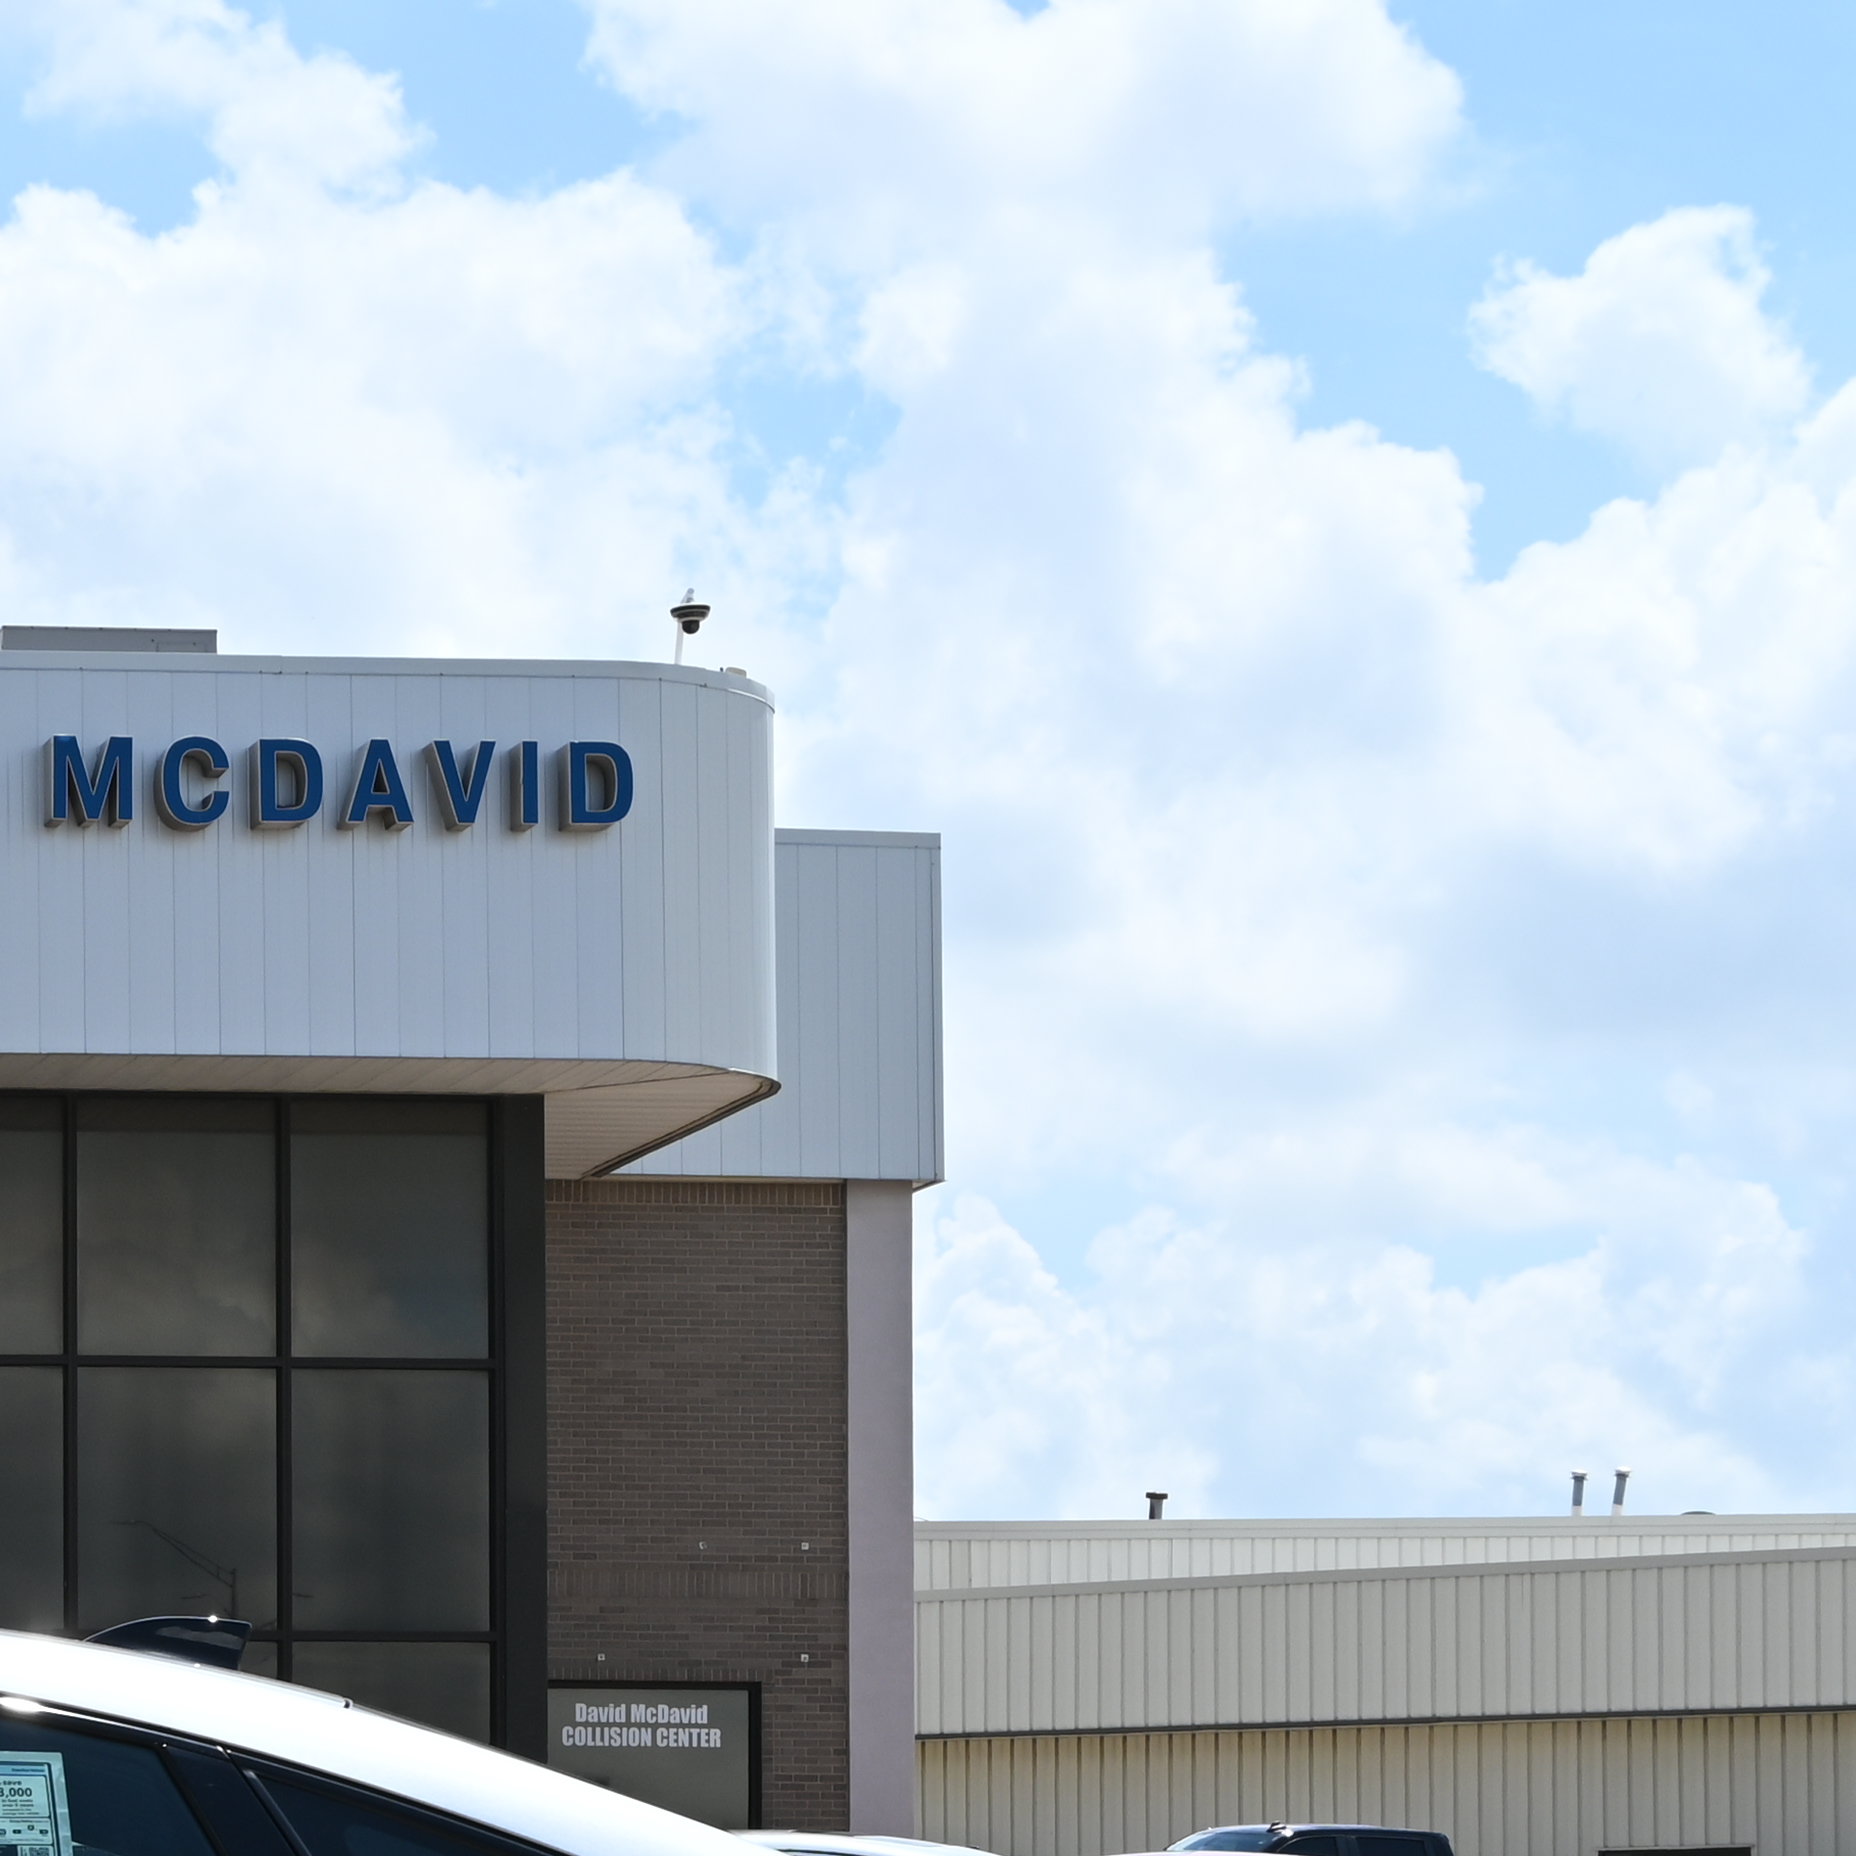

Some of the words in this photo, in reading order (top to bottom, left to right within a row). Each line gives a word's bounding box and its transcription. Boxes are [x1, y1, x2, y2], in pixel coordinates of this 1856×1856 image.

[42, 735, 635, 834] MCDAVID
[575, 1703, 626, 1723] David
[630, 1704, 708, 1724] McDavid
[561, 1726, 652, 1747] COLLISION
[656, 1727, 722, 1748] CENTER
